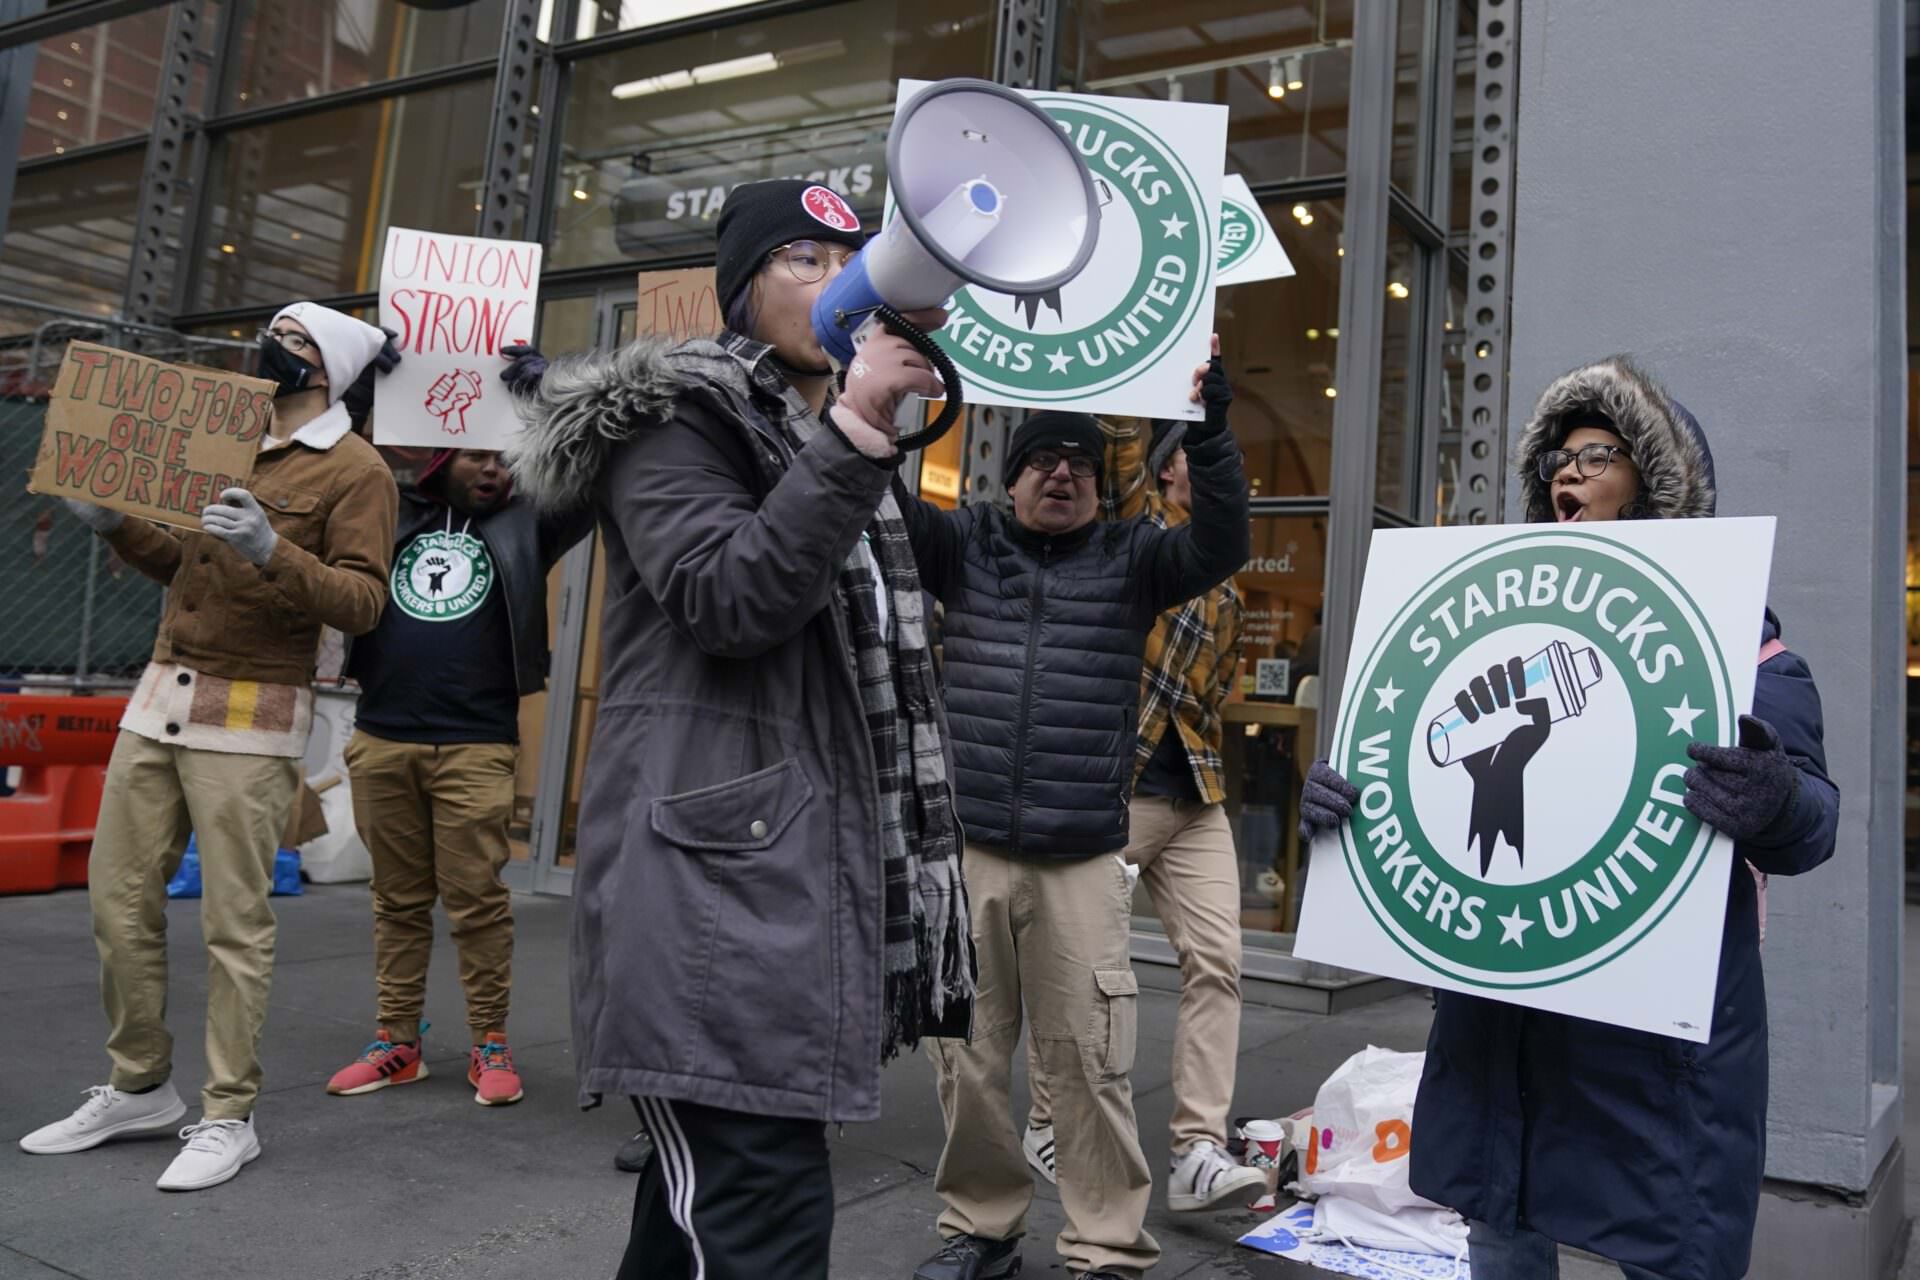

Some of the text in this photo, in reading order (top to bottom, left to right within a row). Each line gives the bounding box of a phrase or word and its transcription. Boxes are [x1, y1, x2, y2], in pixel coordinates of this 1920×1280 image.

[666, 164, 873, 219] STAKS
[391, 234, 533, 290] UNION
[390, 289, 528, 361] STRONG
[642, 280, 716, 341] TWO
[1077, 254, 1186, 367] UNITED
[71, 348, 269, 441] TWO JOBS
[56, 431, 247, 517] WORKER
[108, 413, 192, 468] ONE
[397, 568, 487, 614] WORKERS UNITED
[1409, 563, 1684, 684] STARBUCKS
[1357, 729, 1689, 941] WORKERS UNITED
